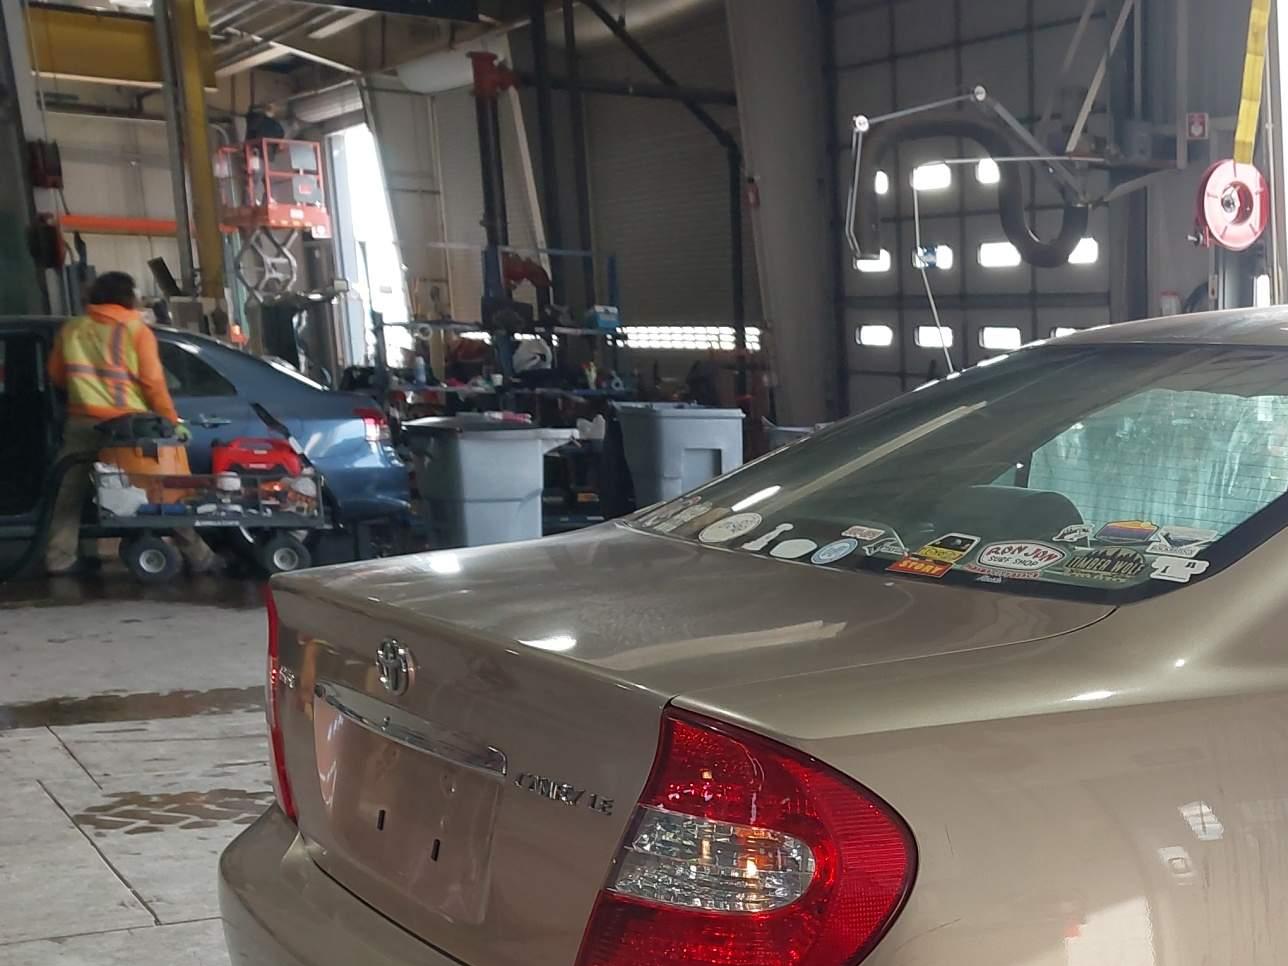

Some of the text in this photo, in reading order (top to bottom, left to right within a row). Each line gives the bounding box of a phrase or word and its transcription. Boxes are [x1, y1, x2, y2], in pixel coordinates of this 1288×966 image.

[986, 544, 1059, 562] RON JON
[988, 555, 1039, 567] SURF SHOP
[898, 558, 944, 575] STORY
[1068, 556, 1112, 572] TIMBER
[1110, 560, 1145, 576] WOLF
